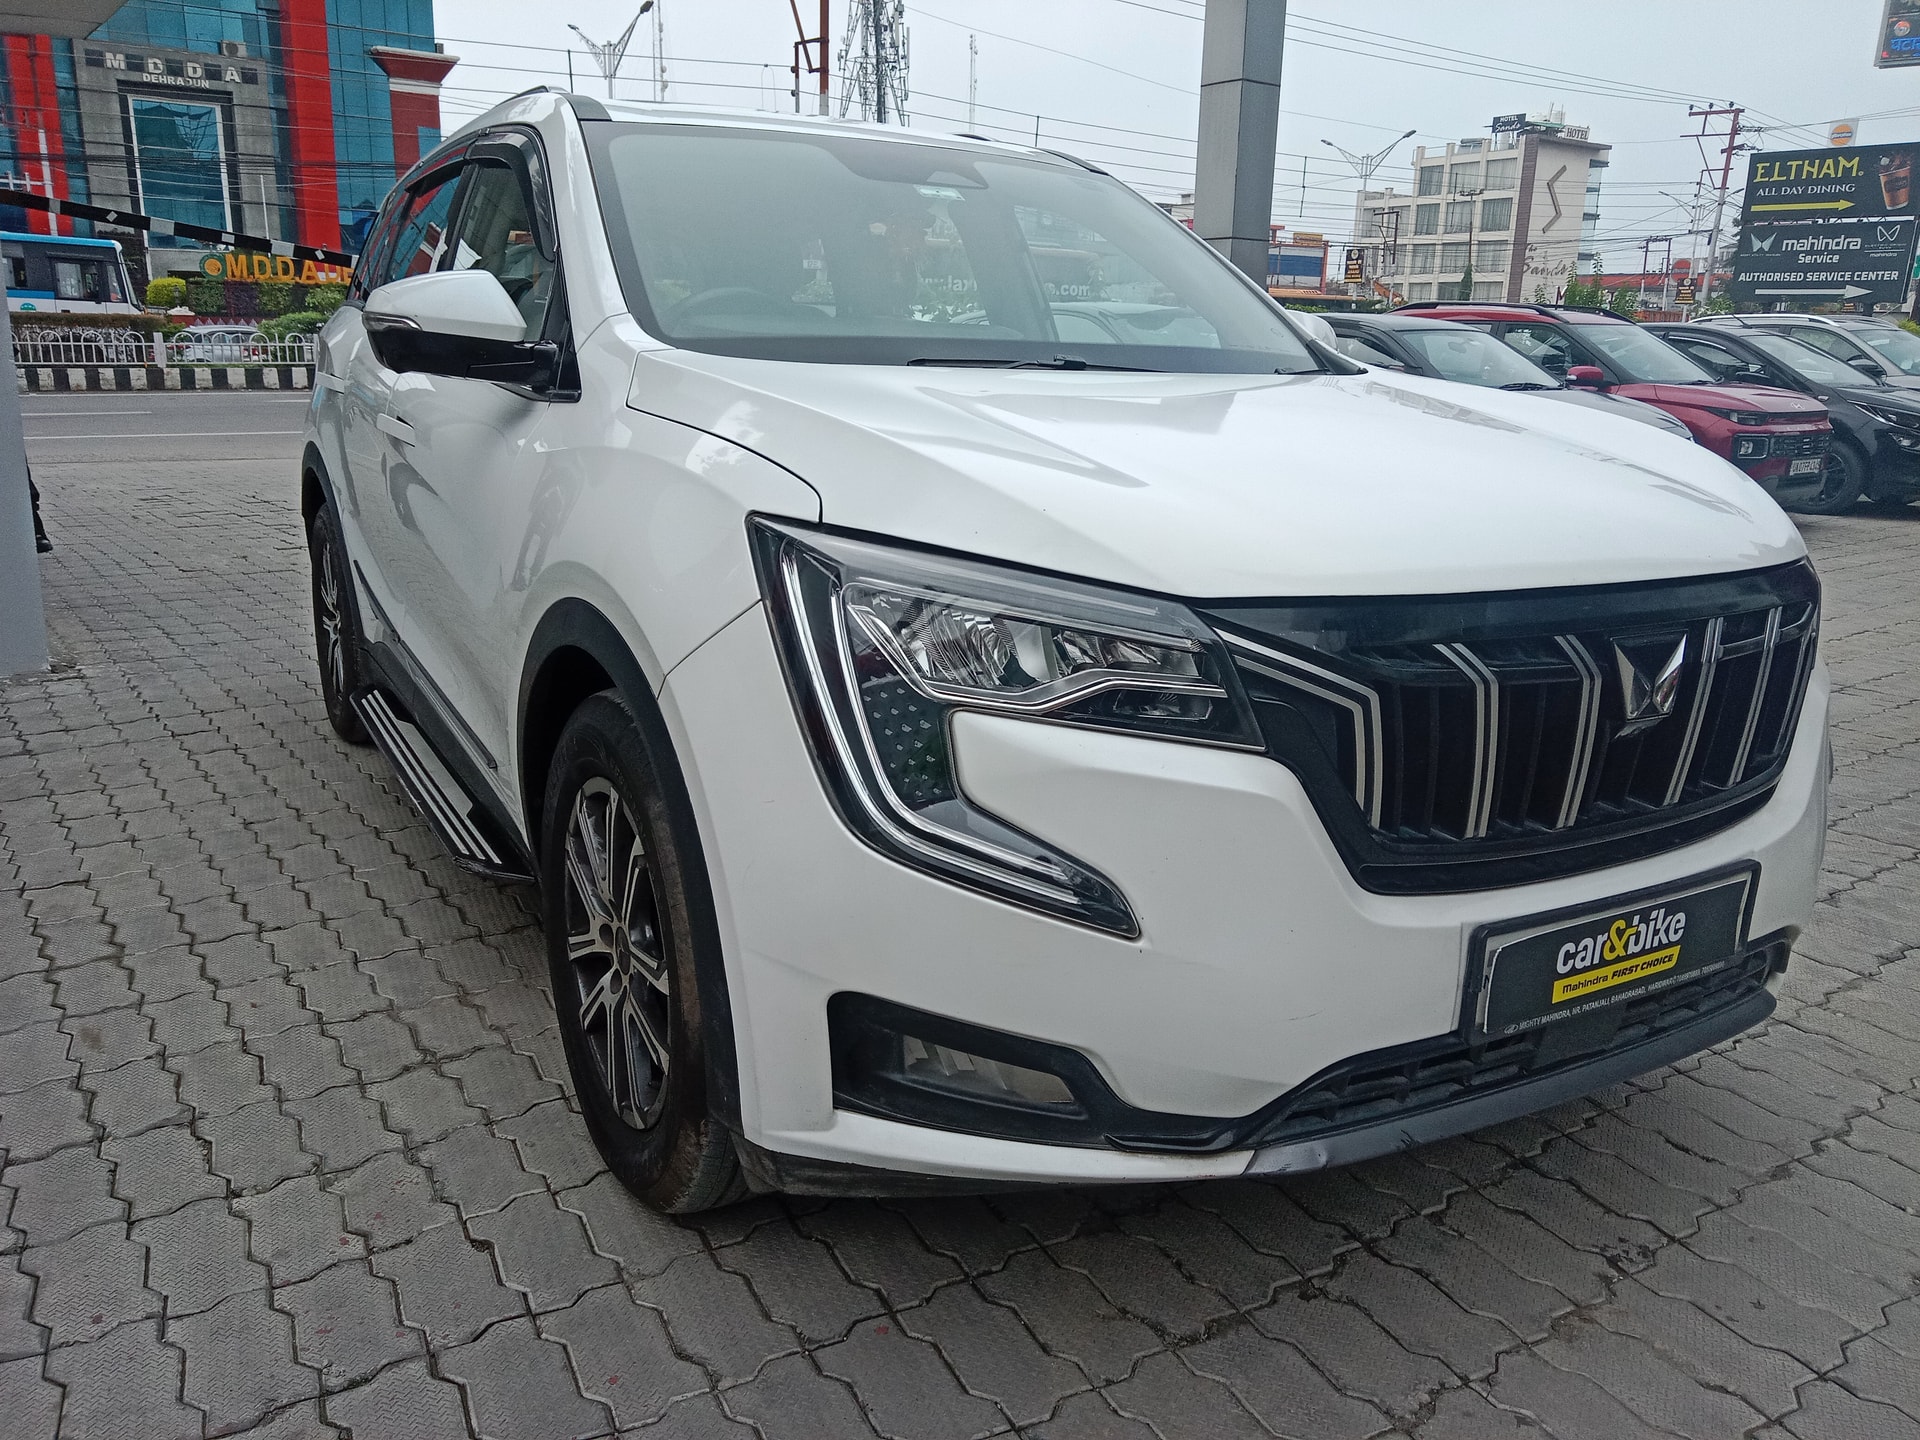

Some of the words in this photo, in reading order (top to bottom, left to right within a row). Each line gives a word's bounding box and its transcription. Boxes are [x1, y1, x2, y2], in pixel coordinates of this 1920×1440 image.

[142, 73, 210, 89] DEHRADUN
[1495, 121, 1521, 132] Sands
[1566, 128, 1589, 140] HOTEL
[1756, 187, 1778, 197] ALL
[1781, 185, 1806, 195] DAY
[1807, 183, 1856, 194] DINING
[1782, 234, 1862, 252] mahindra
[1797, 253, 1840, 264] Service
[1738, 272, 1804, 282] AUTHORISED
[1805, 271, 1852, 282] SERVICE
[1854, 270, 1899, 281] CENTER
[1556, 908, 1687, 974] car&bike
[1562, 974, 1609, 994] Mahindra
[1611, 963, 1642, 980] FIRST
[1640, 953, 1675, 971] CHOICE
[1519, 1016, 1541, 1030] MIGHTY
